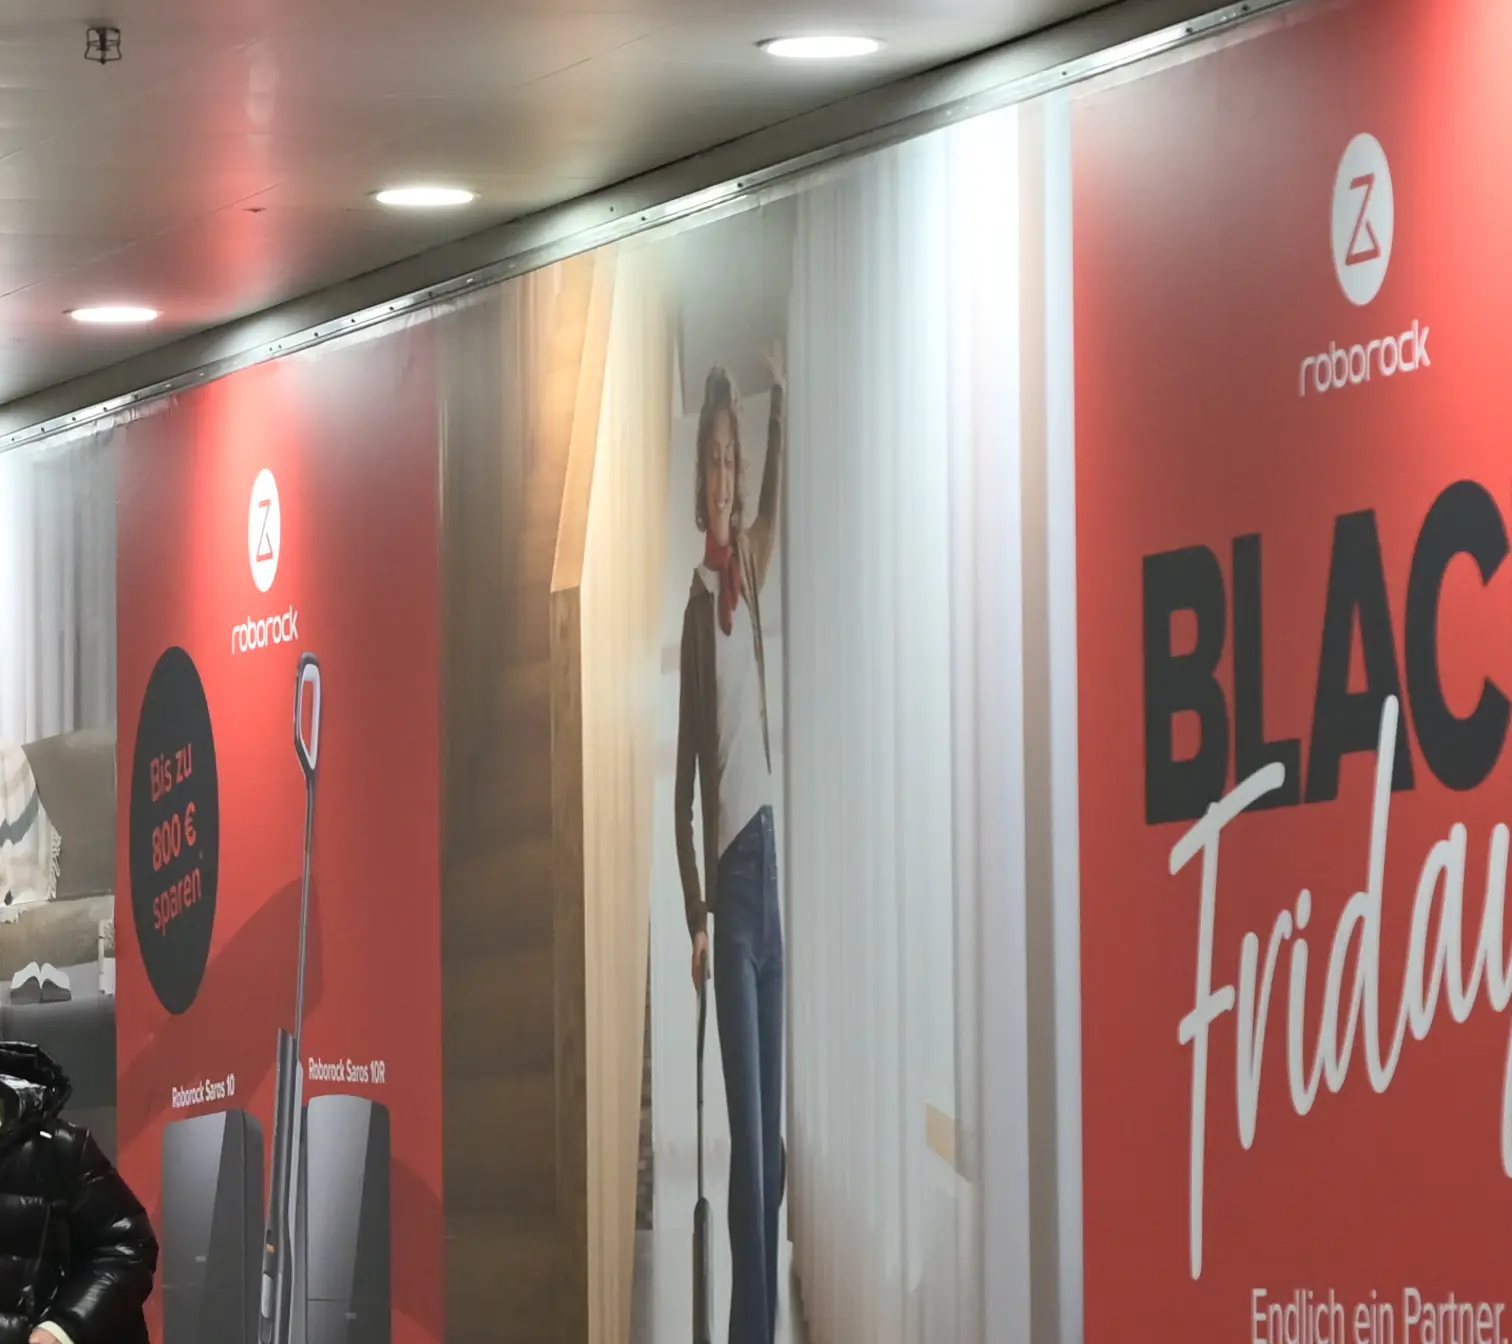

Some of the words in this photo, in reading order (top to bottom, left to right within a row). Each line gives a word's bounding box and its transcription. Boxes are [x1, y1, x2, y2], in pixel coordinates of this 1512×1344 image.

[1298, 318, 1432, 398] roborock
[231, 604, 299, 655] roborock
[149, 752, 173, 803] Bis
[175, 743, 193, 784] zu
[152, 813, 182, 873] 800
[184, 801, 197, 847] €
[153, 867, 203, 937] sparen
[171, 1080, 205, 1109] Roborock
[205, 1078, 225, 1103] Saros
[225, 1073, 235, 1097] 10
[308, 1056, 346, 1082] Roborock
[346, 1057, 369, 1083] Saros
[370, 1060, 385, 1084] 10R
